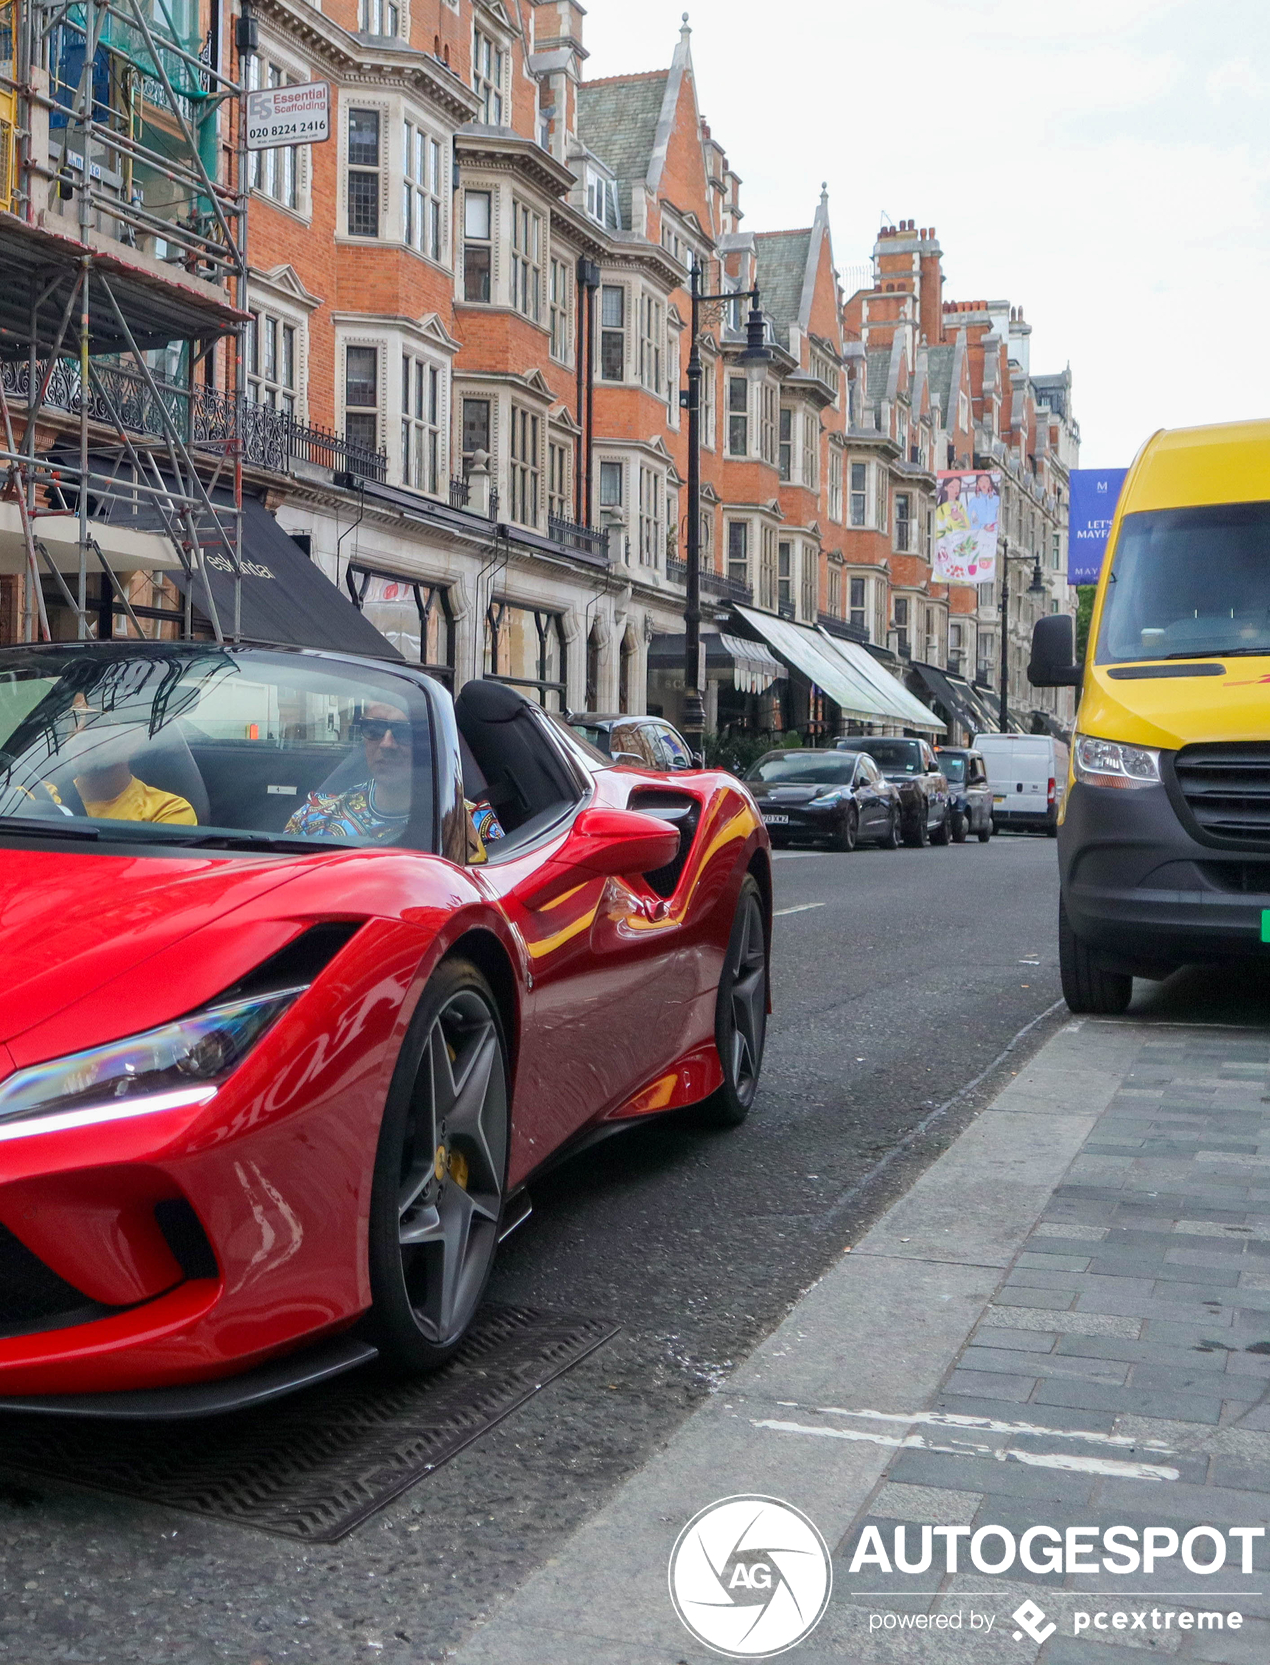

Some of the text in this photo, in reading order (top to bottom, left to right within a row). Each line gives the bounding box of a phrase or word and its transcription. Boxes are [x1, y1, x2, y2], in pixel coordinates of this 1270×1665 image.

[273, 87, 326, 105] Essential
[274, 101, 326, 114] Scaffolding
[249, 120, 326, 139] 020 8224 2416
[1096, 481, 1108, 491] M
